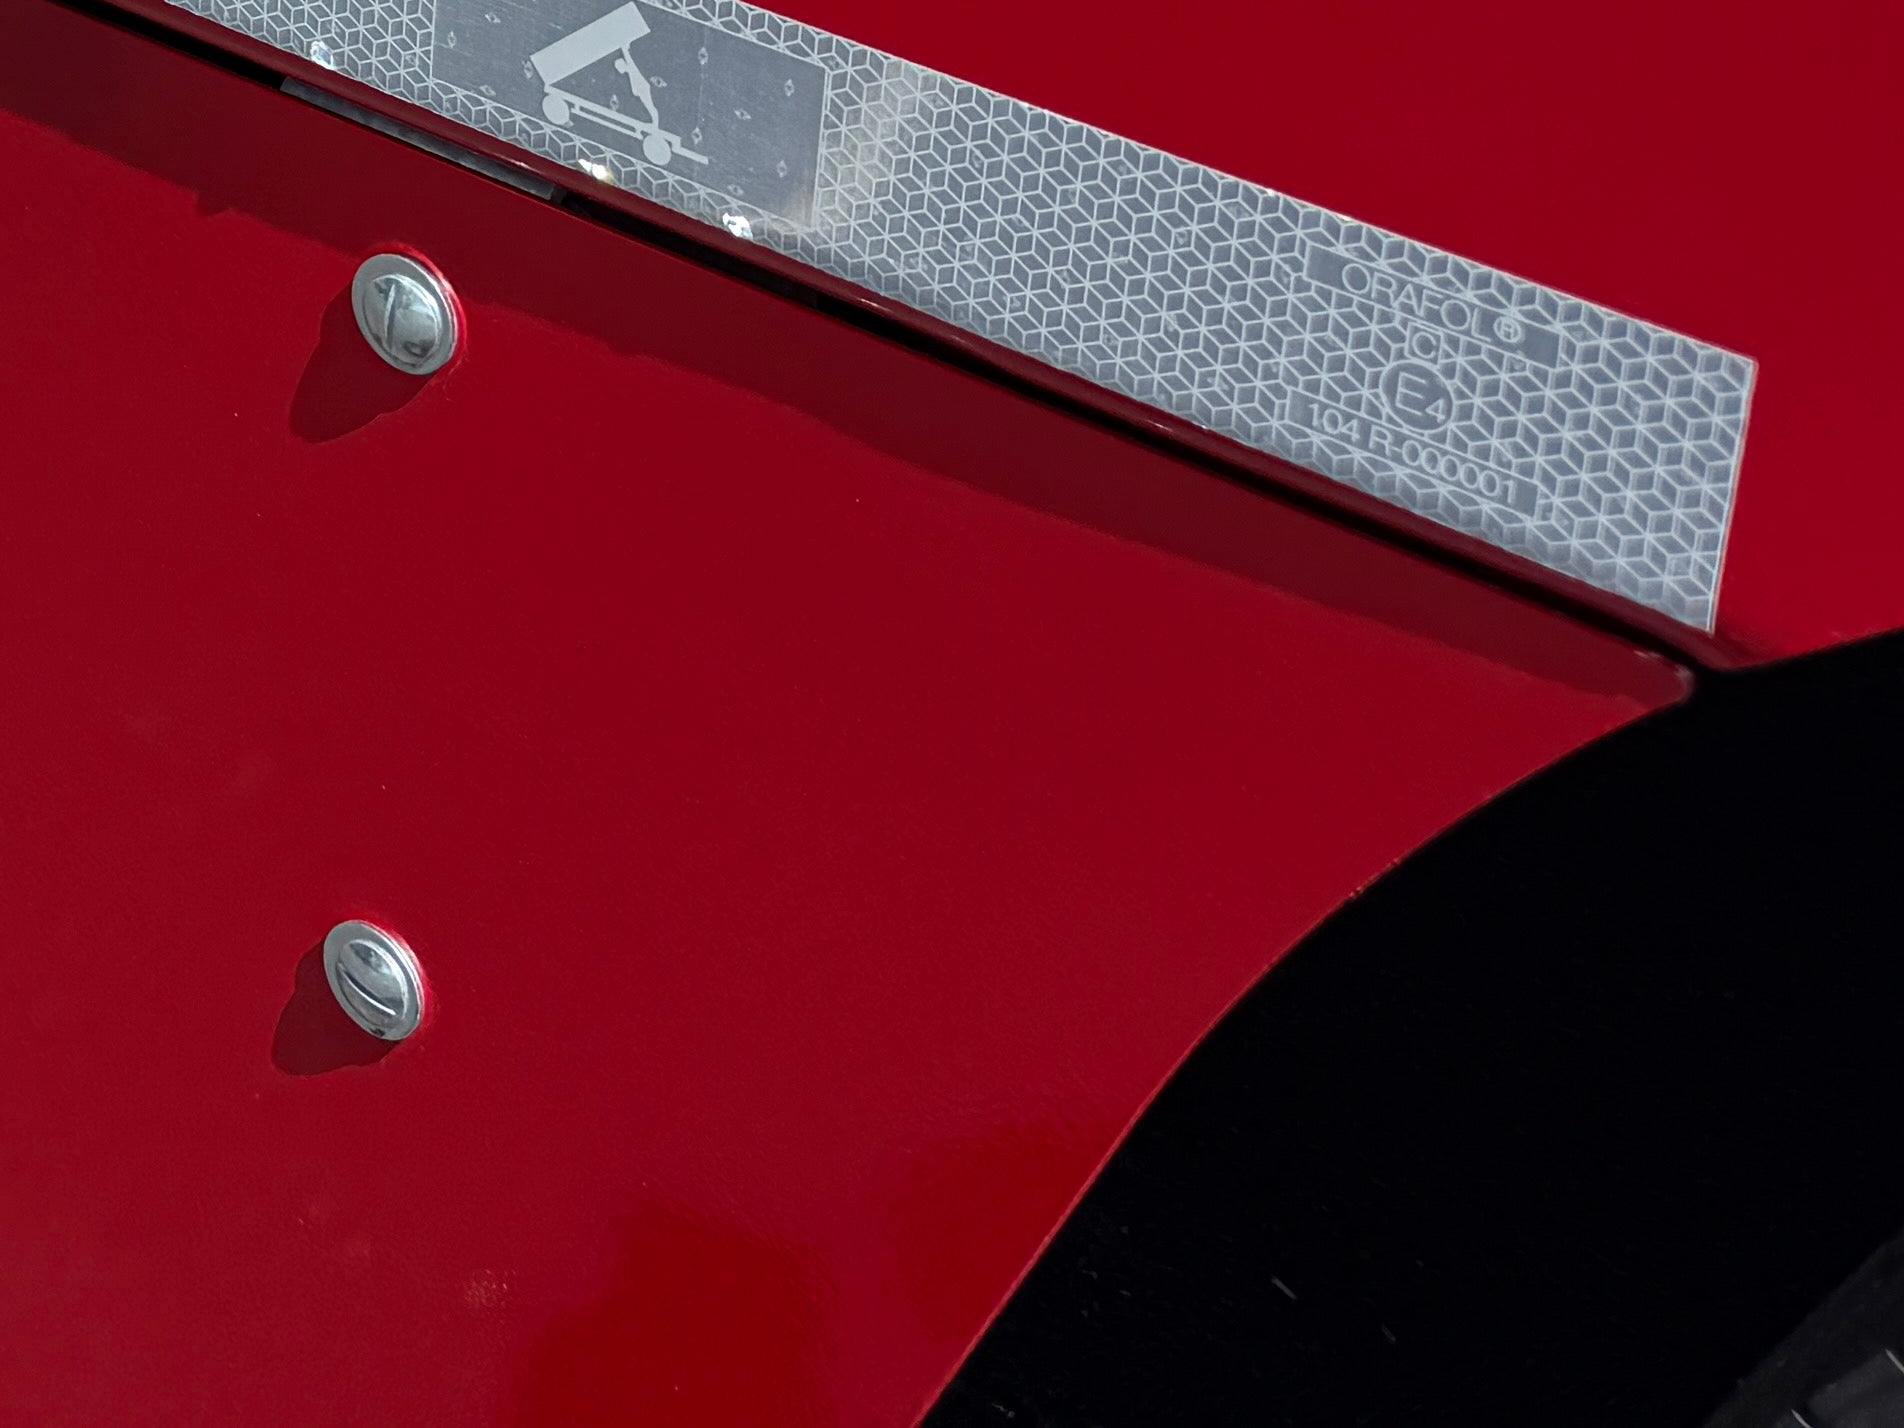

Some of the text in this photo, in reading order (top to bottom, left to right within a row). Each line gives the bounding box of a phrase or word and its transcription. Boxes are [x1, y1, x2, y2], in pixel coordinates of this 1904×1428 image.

[1411, 331, 1438, 359] C
[1307, 402, 1515, 504] 104 R-000001
